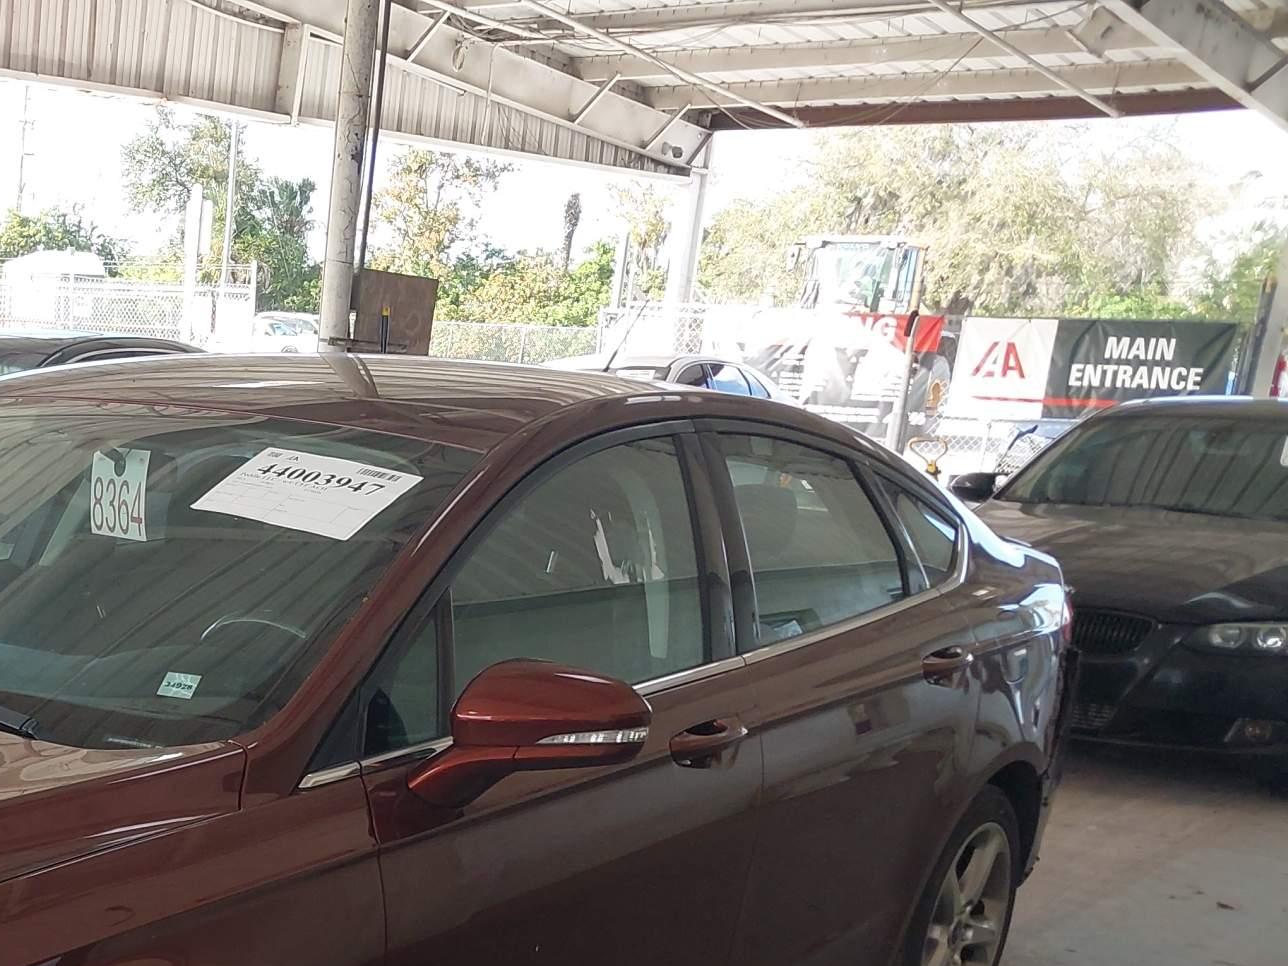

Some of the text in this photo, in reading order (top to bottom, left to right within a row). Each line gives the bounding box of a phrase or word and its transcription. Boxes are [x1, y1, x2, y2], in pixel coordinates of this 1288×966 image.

[1104, 336, 1177, 361] MAIN
[1068, 363, 1204, 391] ENTRANCE
[257, 463, 386, 496] 44003947
[93, 476, 143, 536] 8364
